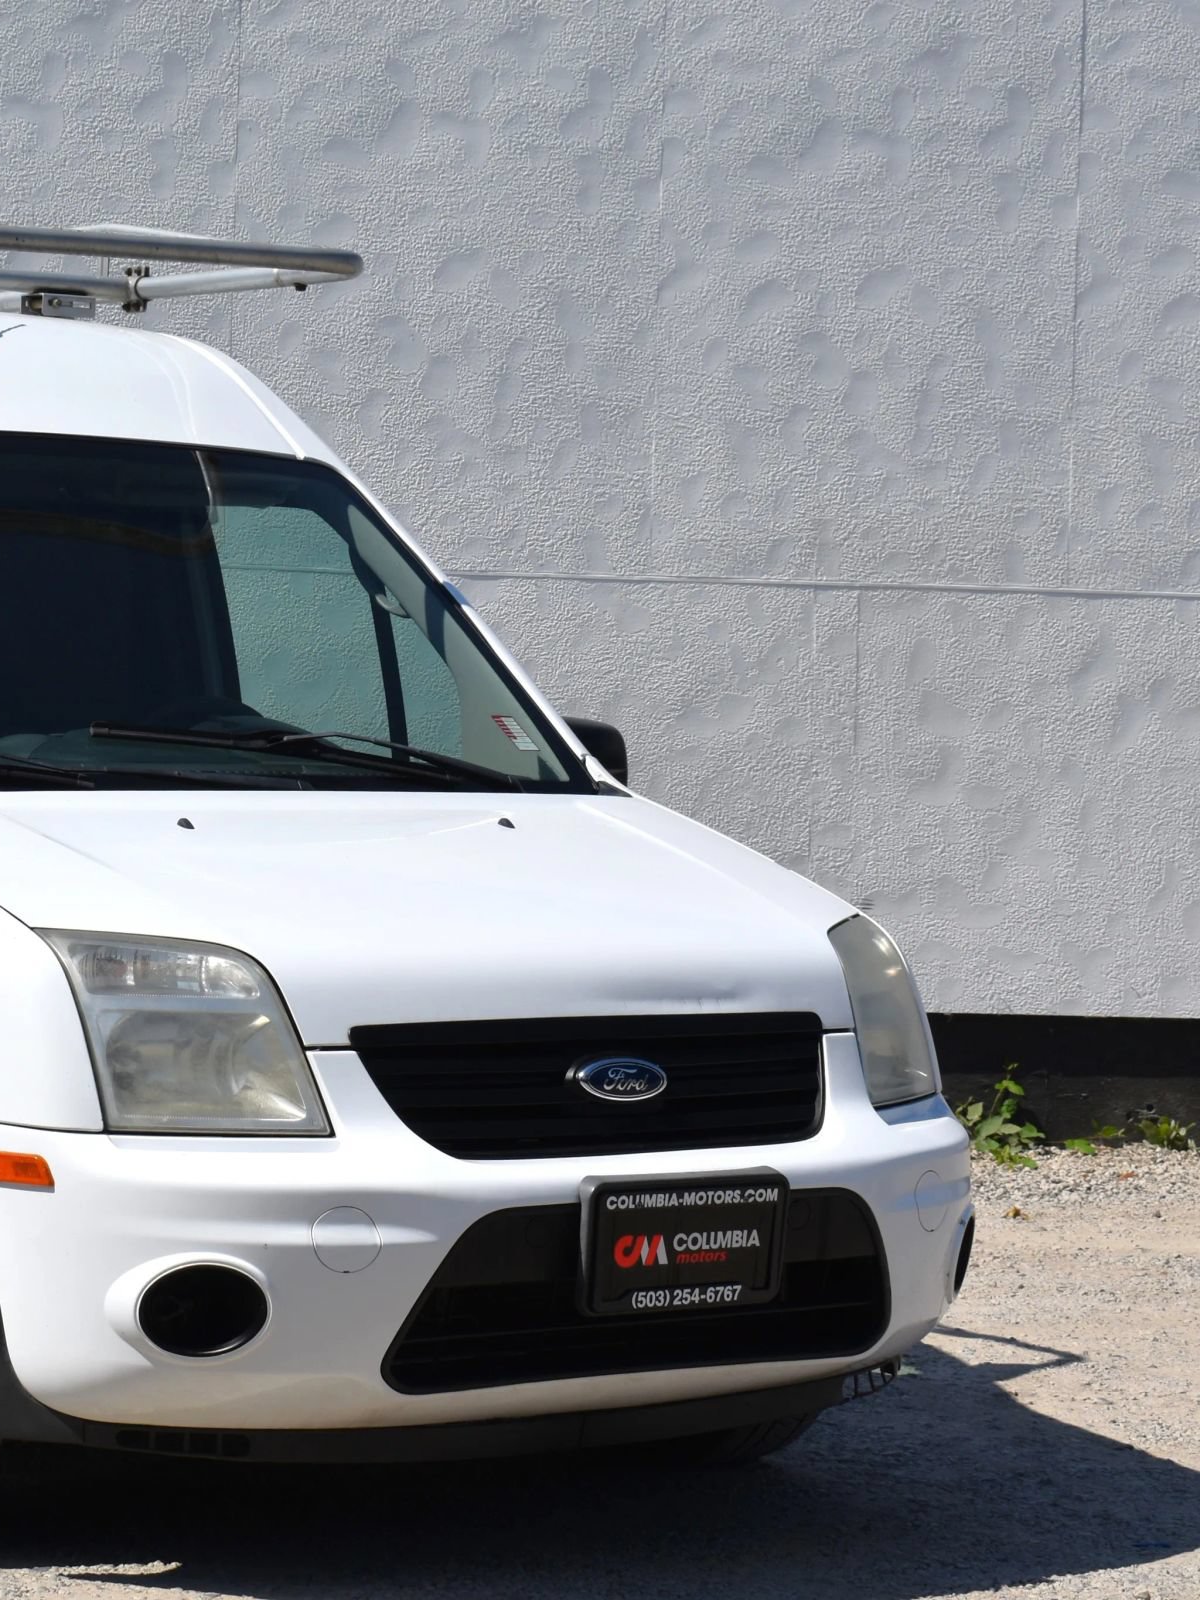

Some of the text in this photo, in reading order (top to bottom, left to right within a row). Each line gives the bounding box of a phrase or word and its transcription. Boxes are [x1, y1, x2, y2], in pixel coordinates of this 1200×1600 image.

[603, 1067, 649, 1091] Ford
[672, 1229, 760, 1252] COLUMBIA
[675, 1250, 728, 1264] motors
[631, 1285, 742, 1310] (503) 254-6767
